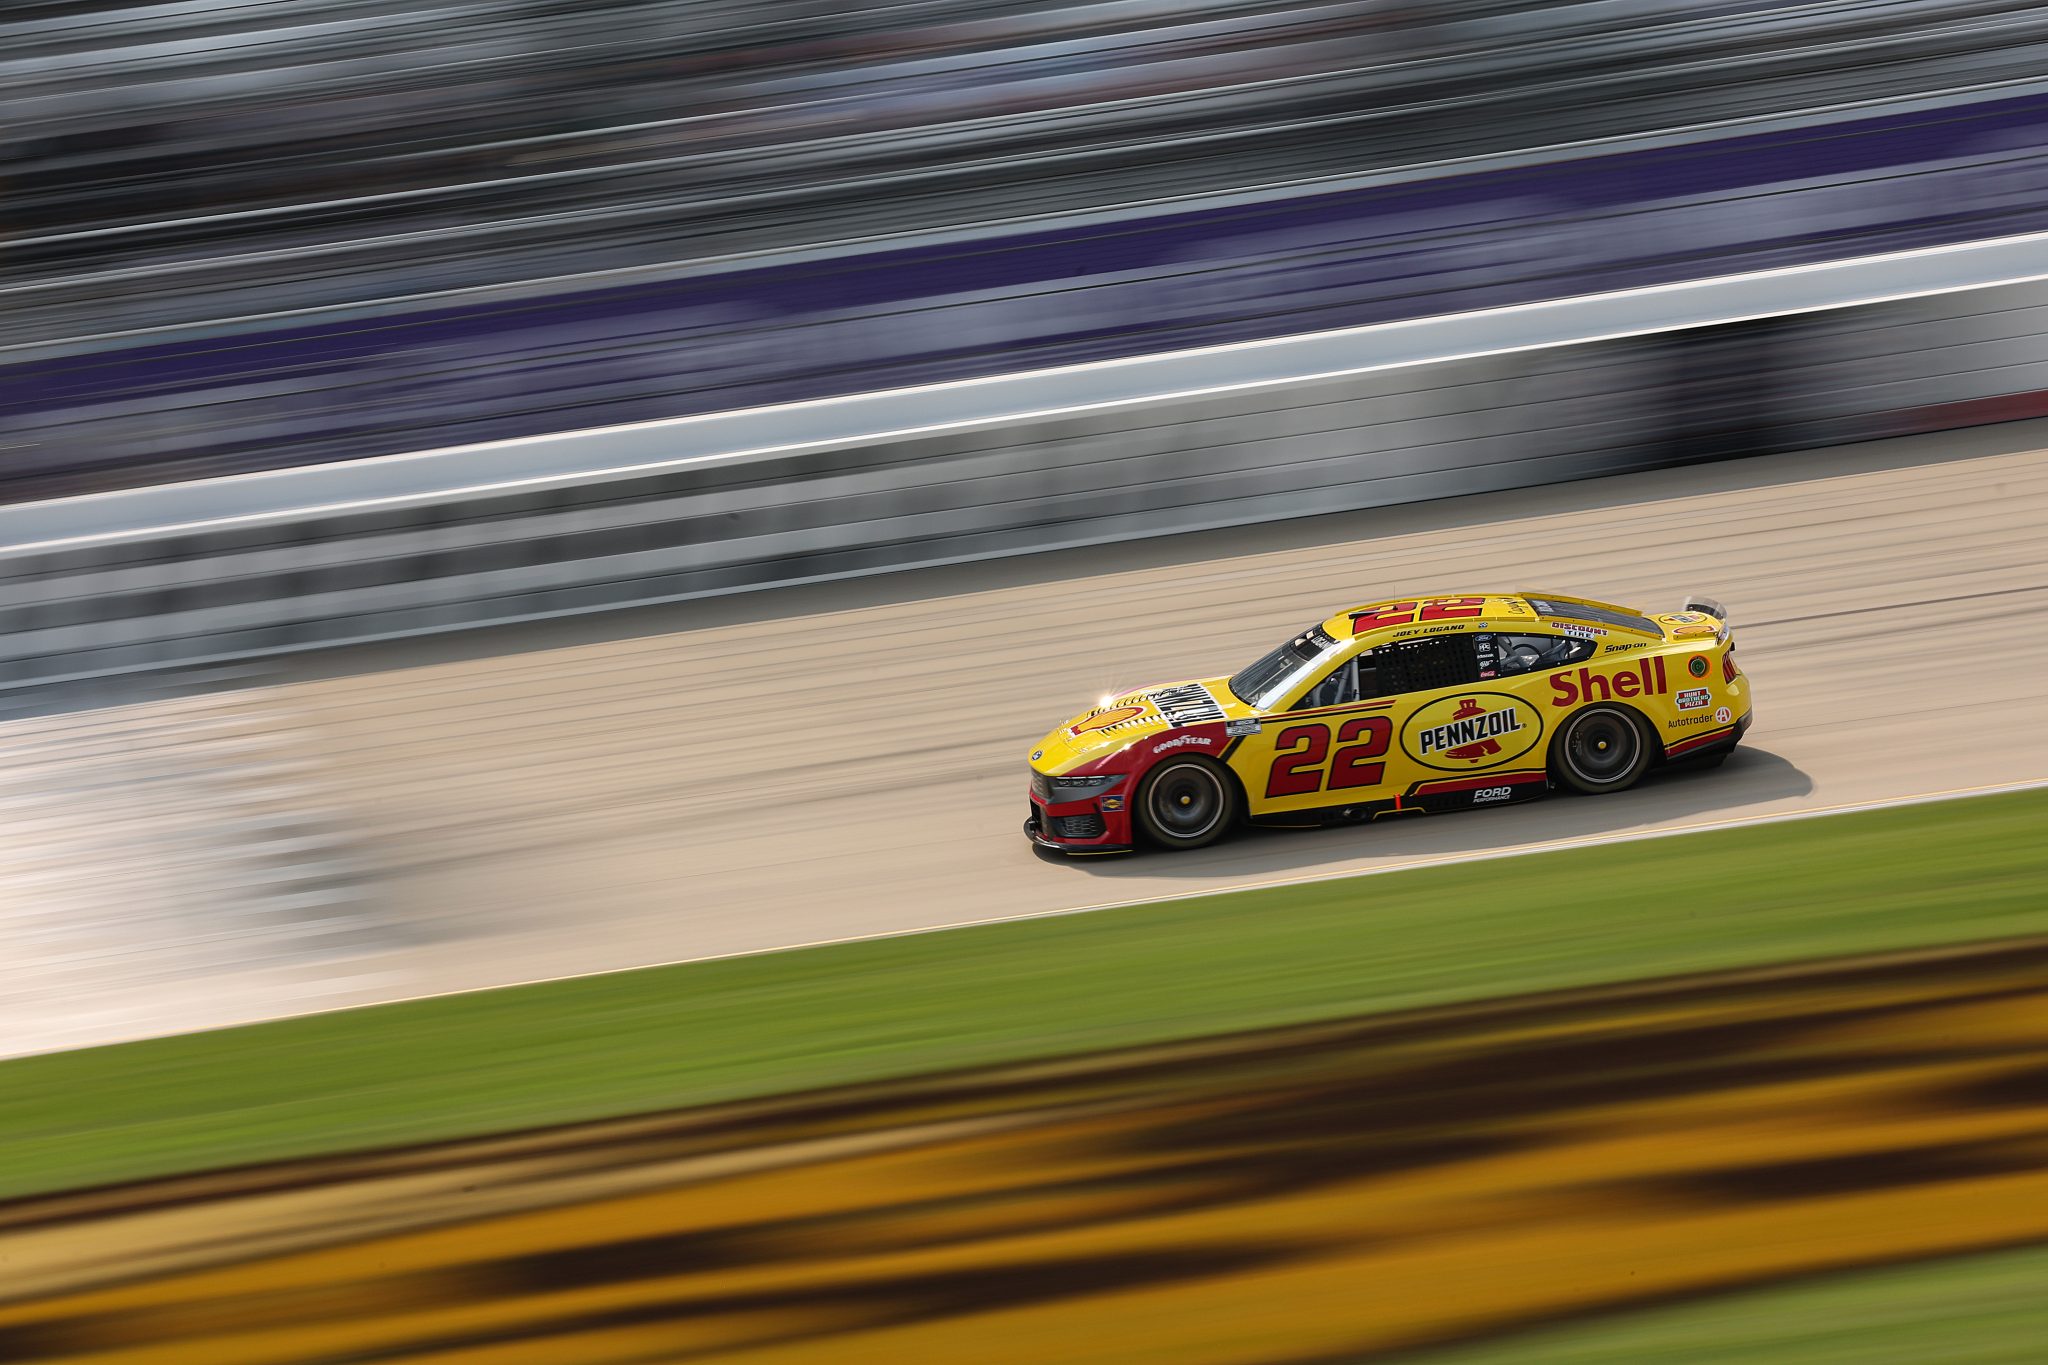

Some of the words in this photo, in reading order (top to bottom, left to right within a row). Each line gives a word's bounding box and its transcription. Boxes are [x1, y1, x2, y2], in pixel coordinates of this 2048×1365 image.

[1352, 598, 1486, 636] 22
[1393, 629, 1421, 638] JOEY
[1423, 624, 1465, 634] LOGANO
[1551, 622, 1609, 636] DISCOUNT
[1566, 630, 1593, 639] TIRE
[1604, 642, 1647, 653] Snap-on
[1549, 656, 1667, 707] Shell
[1684, 700, 1703, 708] PIZZA
[1668, 714, 1714, 728] Autotrader
[1420, 707, 1522, 756] PENNZOIL
[1153, 735, 1212, 754] GOODYEAR
[1264, 715, 1393, 799] 22
[1473, 786, 1512, 798] FORD
